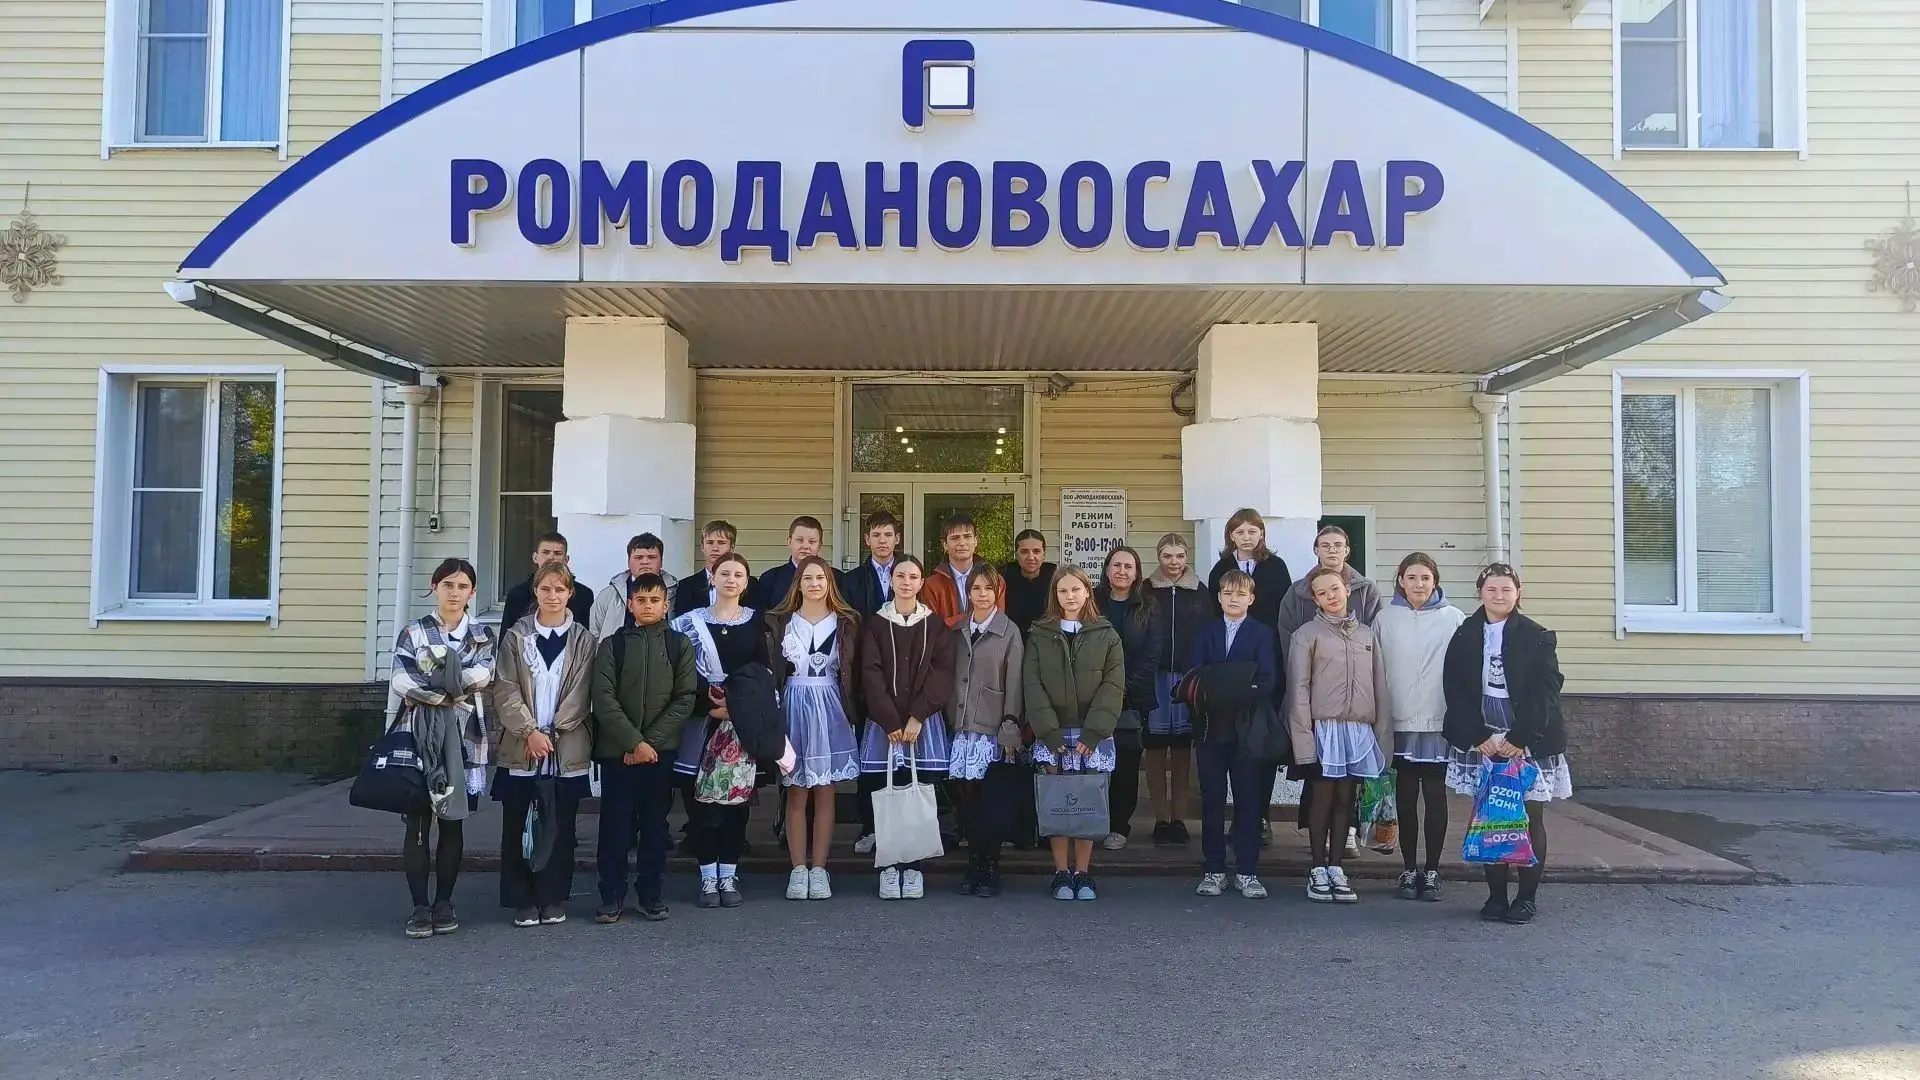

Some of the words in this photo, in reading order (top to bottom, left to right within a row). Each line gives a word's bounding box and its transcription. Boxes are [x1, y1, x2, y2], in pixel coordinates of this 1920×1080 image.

[450, 158, 1445, 263] РОМОДАНОВОСАХАР
[1075, 512, 1113, 520] РЕЖИМ
[1071, 521, 1117, 529] РАБОТЫ:
[1075, 537, 1124, 552] 8:00-17:00
[1064, 549, 1073, 557] Ср
[1491, 785, 1521, 800] ozon
[1488, 794, 1518, 812] банк
[1492, 832, 1529, 843] OZON
